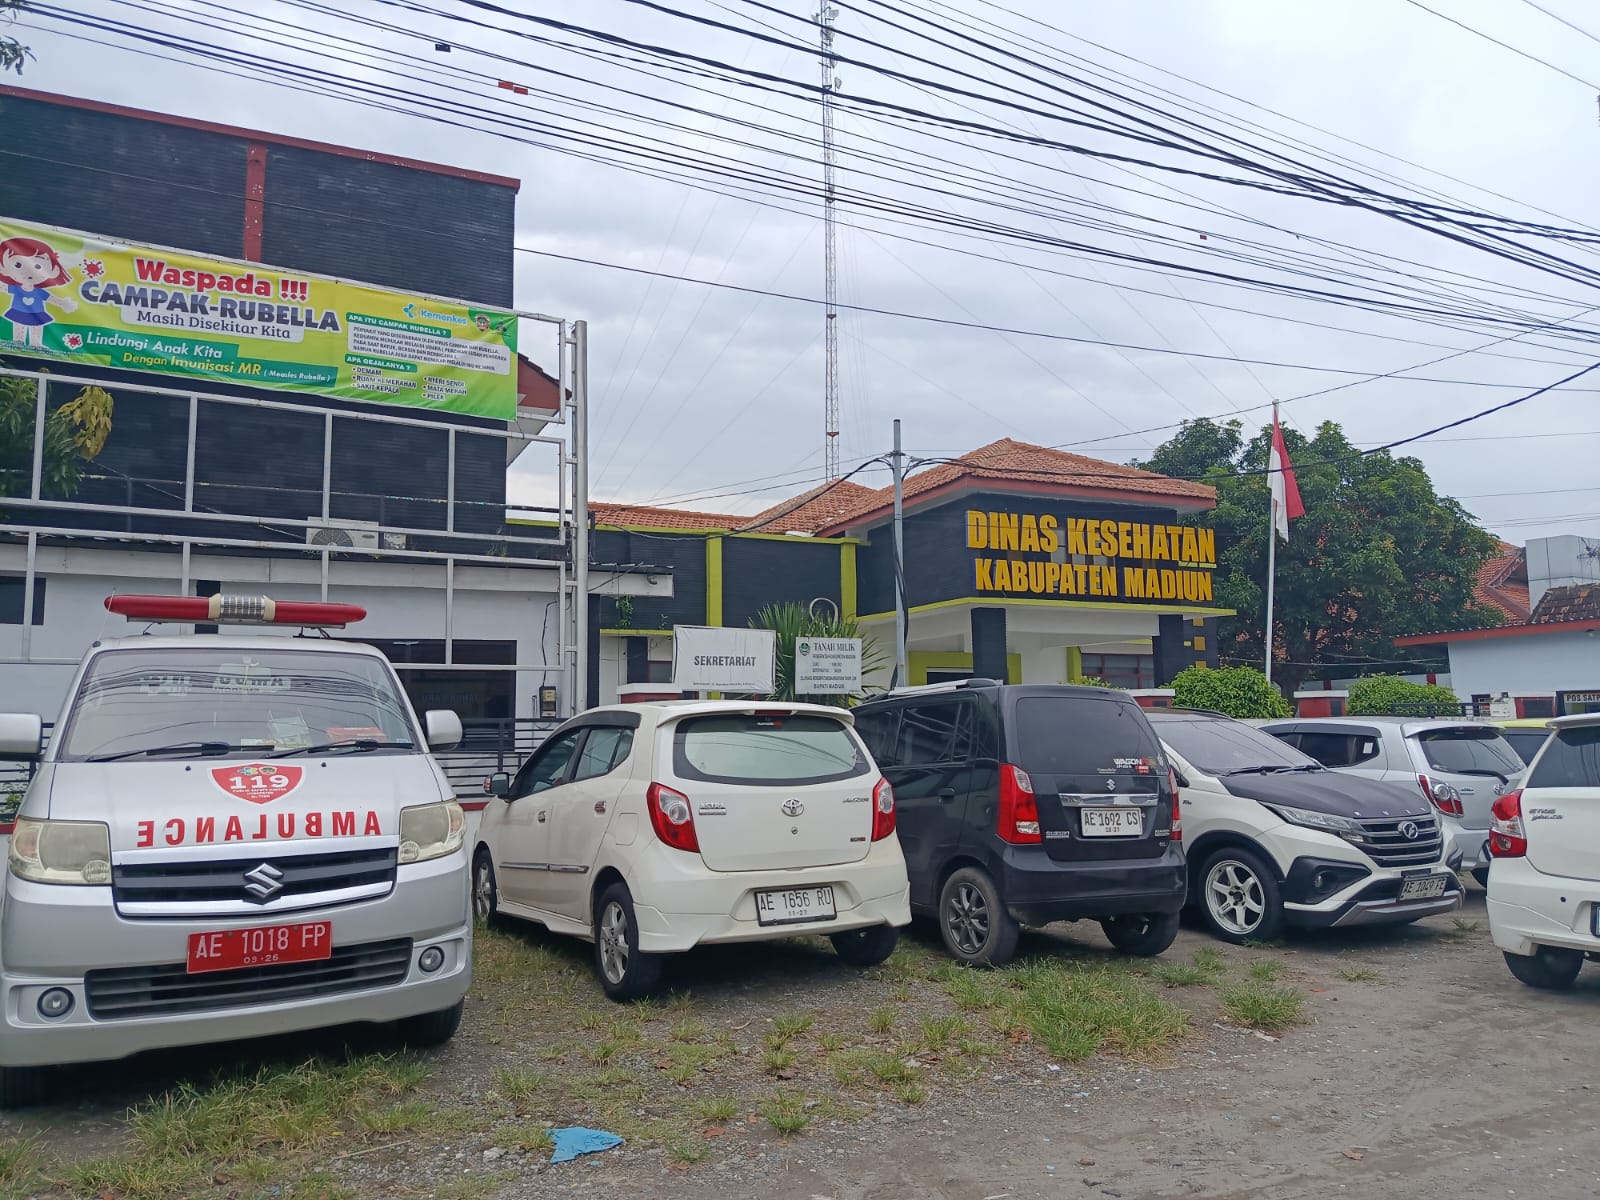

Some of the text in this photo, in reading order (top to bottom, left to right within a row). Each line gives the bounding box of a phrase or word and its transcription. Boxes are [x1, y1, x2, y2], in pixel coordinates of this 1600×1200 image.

[136, 259, 308, 301] Waspada !!!
[81, 280, 340, 332] CAMPAK-RUBELLA
[421, 309, 468, 324] Kemenkes
[137, 311, 290, 339] Masih Disekitar Kita
[348, 314, 363, 323] APA
[378, 319, 409, 330] CAMPAK
[410, 324, 441, 335] RUBELLA
[86, 332, 149, 351] Lindungi
[152, 339, 189, 356] Anak
[193, 344, 223, 359] Kita
[122, 352, 167, 367] Dengan
[170, 355, 234, 373] Imunisasi
[238, 362, 262, 375] MR
[347, 356, 361, 364] APA
[363, 358, 405, 370] GEJALANYA
[357, 367, 382, 376] DEMAM
[966, 510, 1216, 563] DINAS KESEHATAN
[974, 558, 1214, 602] KABUPATEN MADIUN
[814, 643, 856, 651] TANAH MILIK
[694, 655, 756, 667] SEKRETARIAT
[1566, 694, 1581, 702] POS
[229, 775, 289, 789] 119
[1084, 811, 1139, 827] AE 1692 CS
[760, 888, 831, 911] AE 1656 RU
[196, 924, 326, 958] AE 1018 FP
